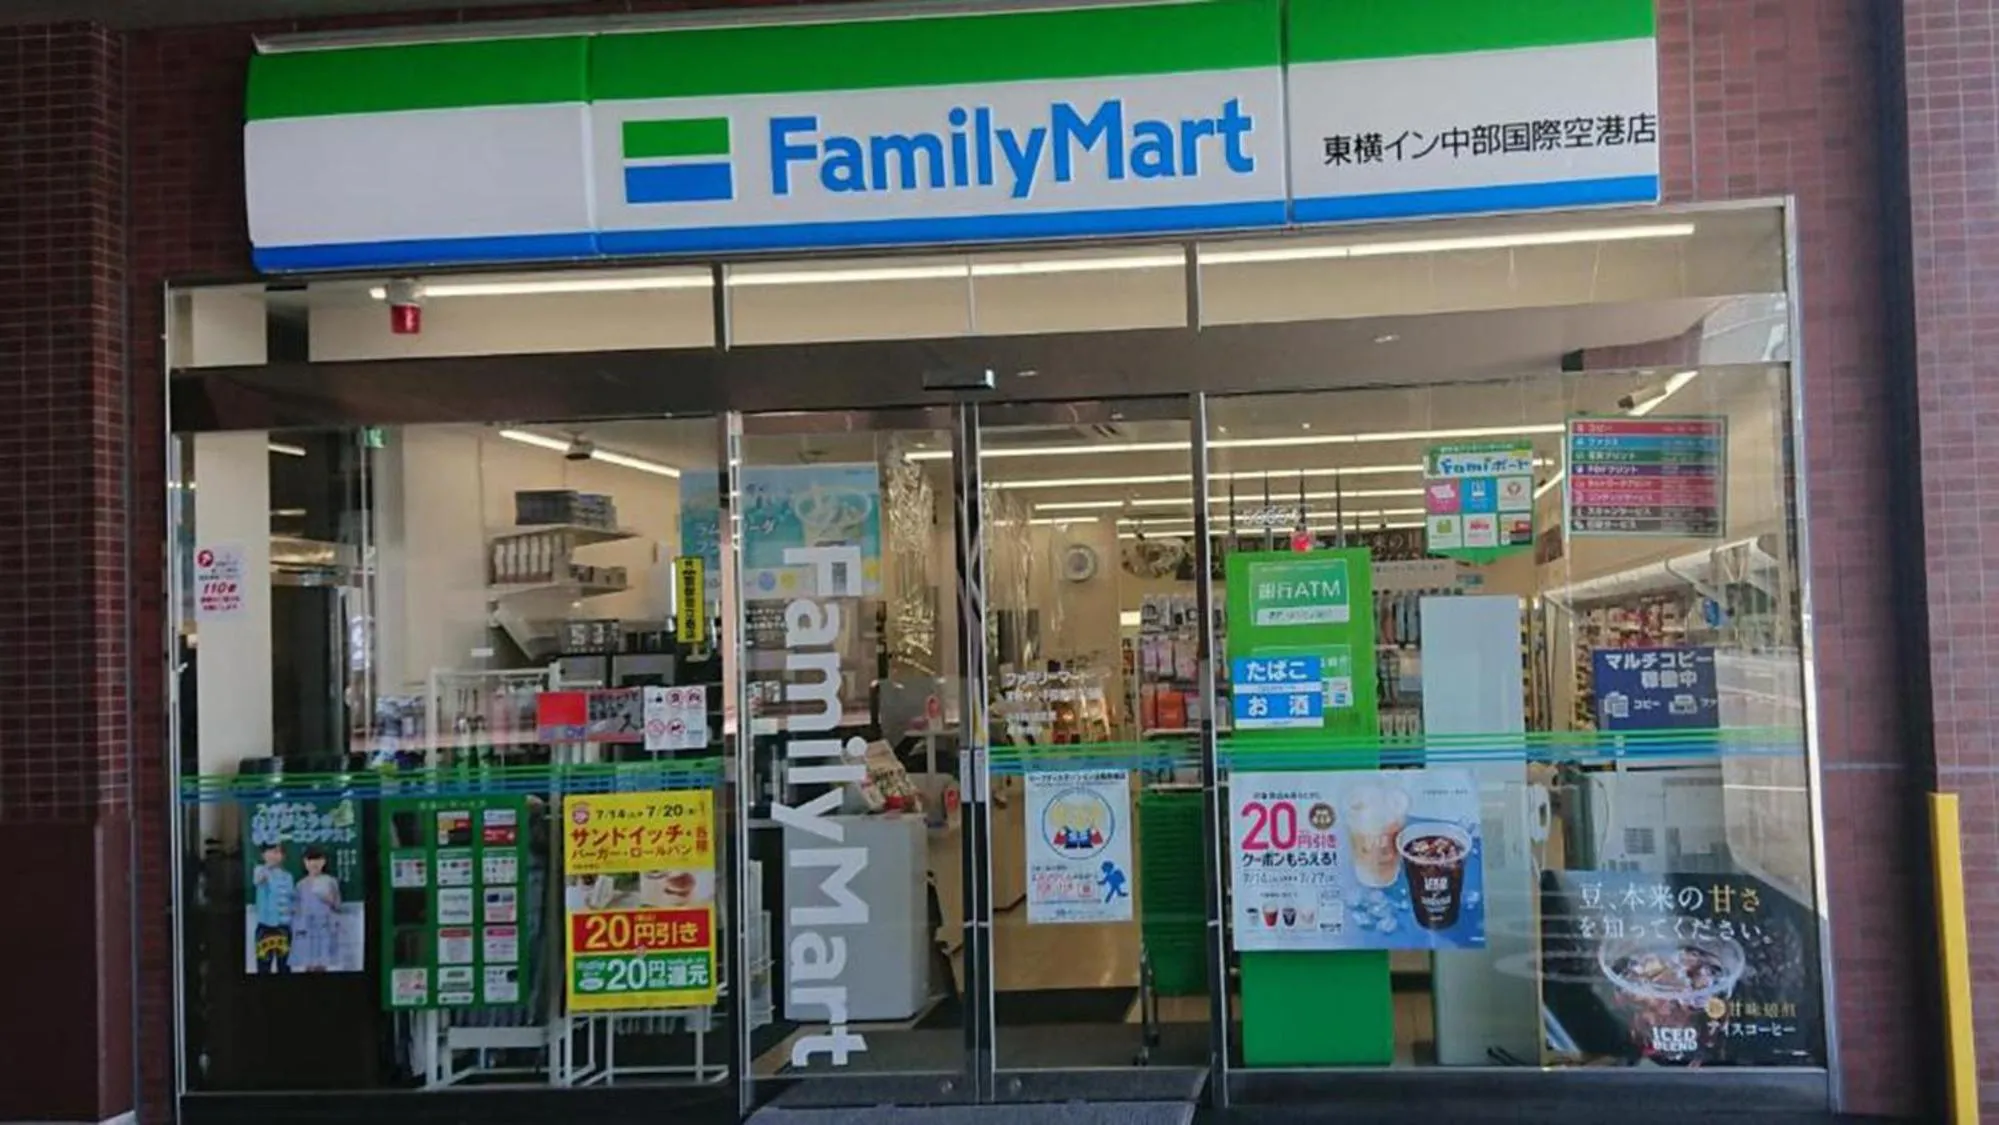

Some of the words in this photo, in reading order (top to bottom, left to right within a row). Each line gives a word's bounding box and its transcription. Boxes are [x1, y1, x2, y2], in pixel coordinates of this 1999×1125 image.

[769, 98, 1254, 199] FamilyMart
[1323, 114, 1656, 166] 東横イン中部国際空港店
[1247, 660, 1308, 682] たばこ
[1605, 651, 1713, 670] マルチコピー
[771, 546, 868, 1067] FamilyMart
[1579, 882, 1760, 913] 豆、本来の甘さ
[585, 914, 699, 949] 20円引き
[1579, 917, 1772, 945] を知ってください。
[1707, 1021, 1796, 1037] アイスコーヒー
